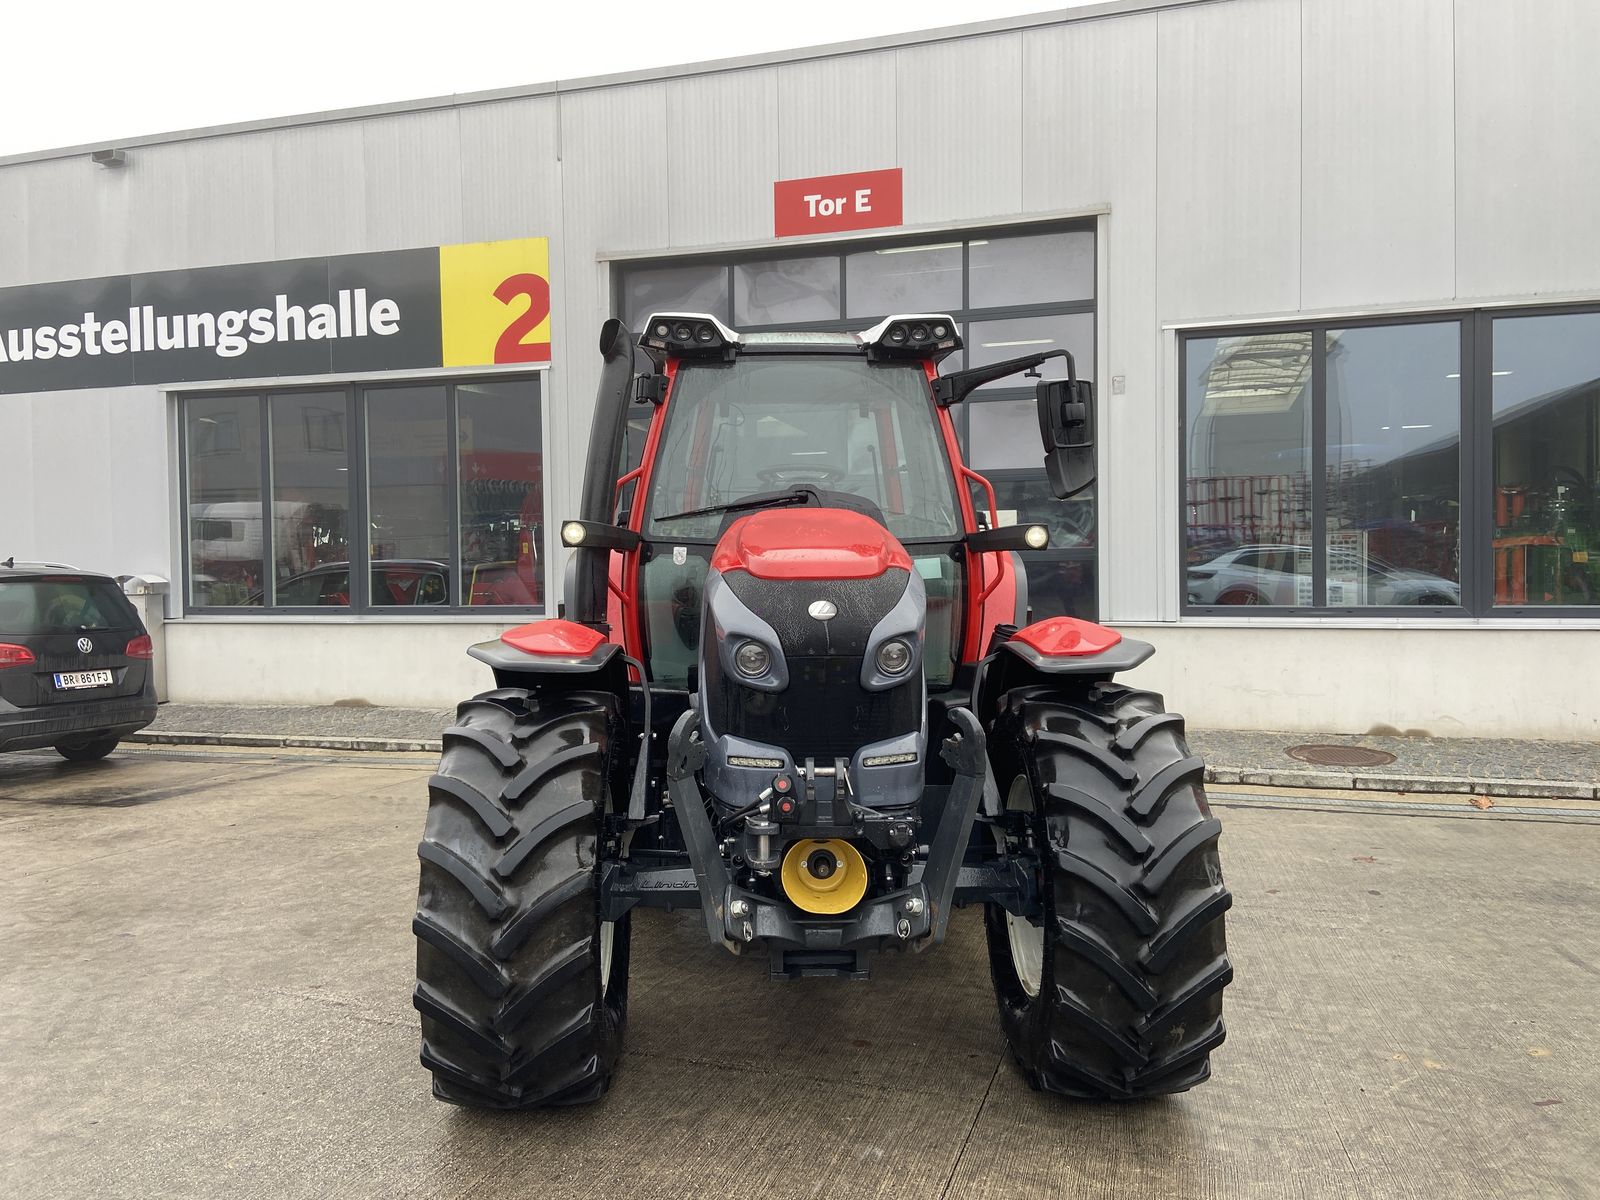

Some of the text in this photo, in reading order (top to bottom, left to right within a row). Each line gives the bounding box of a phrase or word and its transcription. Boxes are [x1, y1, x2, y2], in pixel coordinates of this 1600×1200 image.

[803, 189, 872, 218] Tor E
[0, 272, 552, 365] usstellungshalle 2
[63, 672, 108, 685] BR 861FJ
